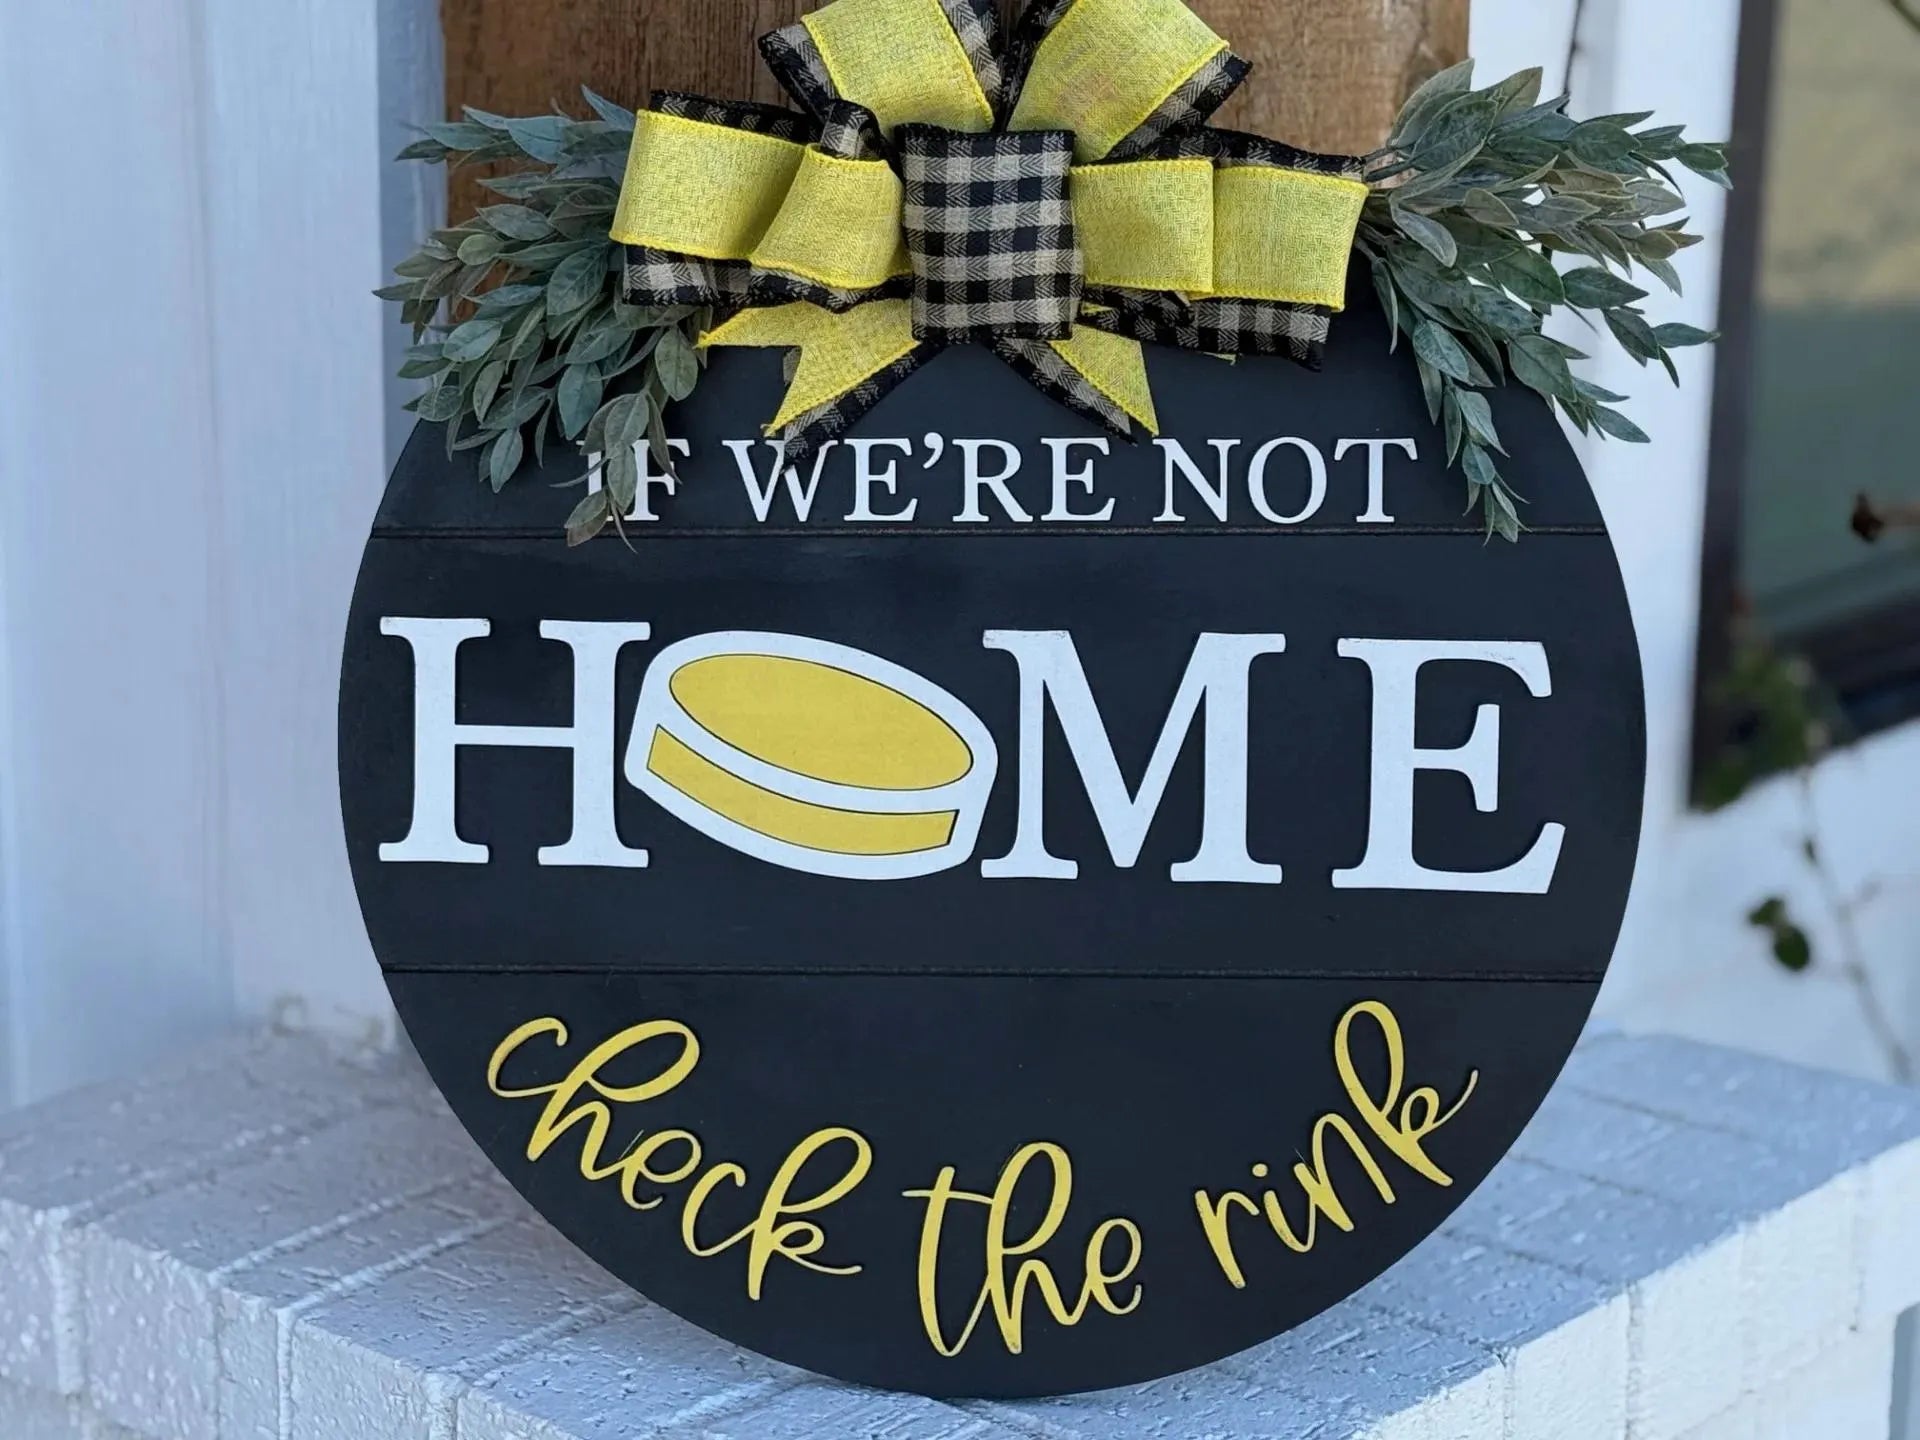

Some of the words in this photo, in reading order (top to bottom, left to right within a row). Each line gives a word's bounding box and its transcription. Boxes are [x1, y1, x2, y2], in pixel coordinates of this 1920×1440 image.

[1153, 436, 1418, 524] NOT
[487, 1016, 873, 1300] check
[902, 1142, 1142, 1357] the
[1194, 1000, 1480, 1290] rink
